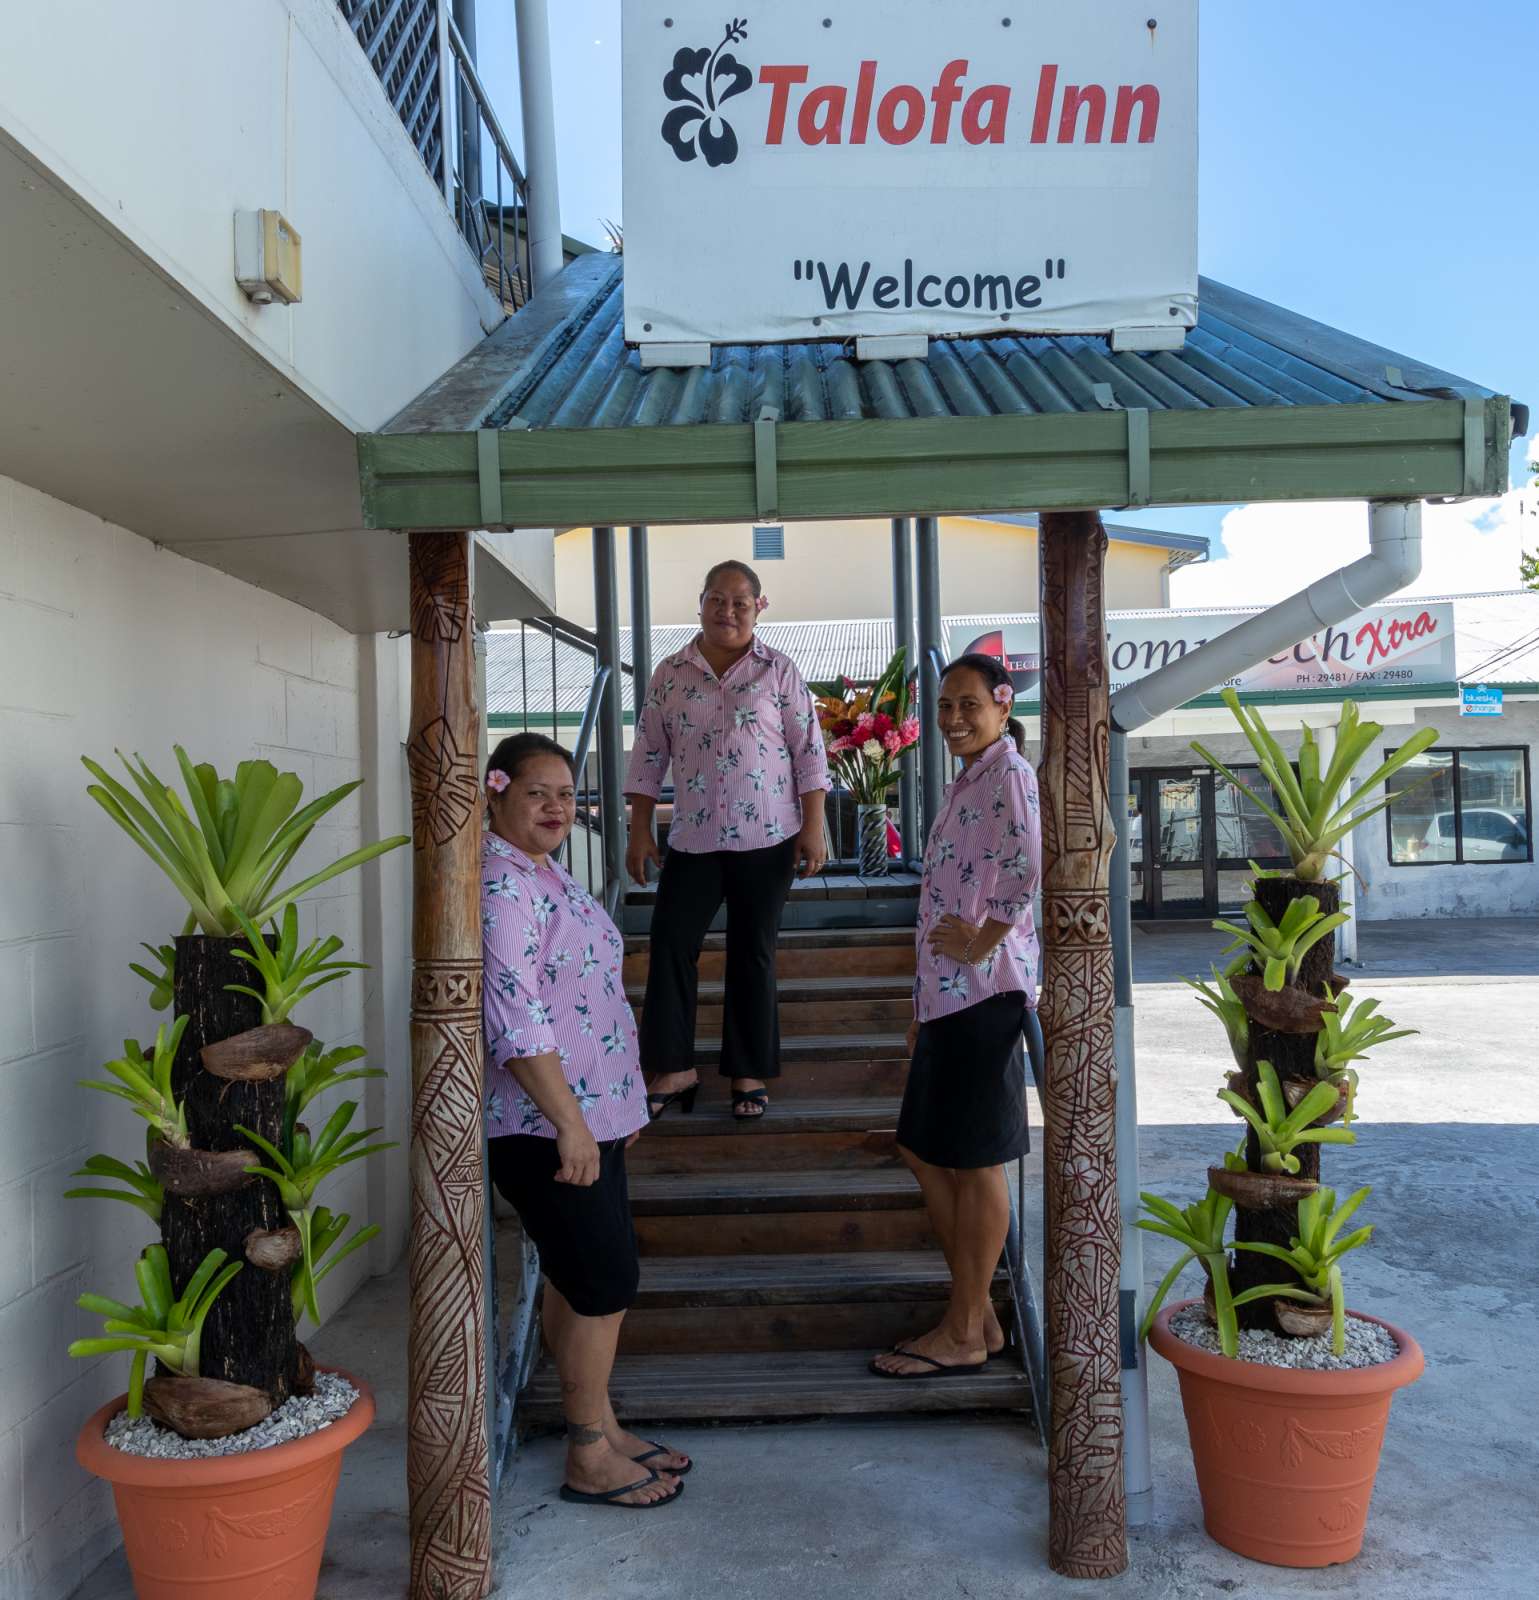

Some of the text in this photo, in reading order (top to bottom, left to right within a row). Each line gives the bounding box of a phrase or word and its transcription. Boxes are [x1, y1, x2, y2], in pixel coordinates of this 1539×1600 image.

[758, 59, 1160, 146] Talofa Inn
[793, 259, 1065, 311] "Welcome"
[1355, 611, 1437, 664] Xtra
[1317, 673, 1346, 683] 29481
[1356, 672, 1375, 681] FAX
[1383, 670, 1413, 680] 29480
